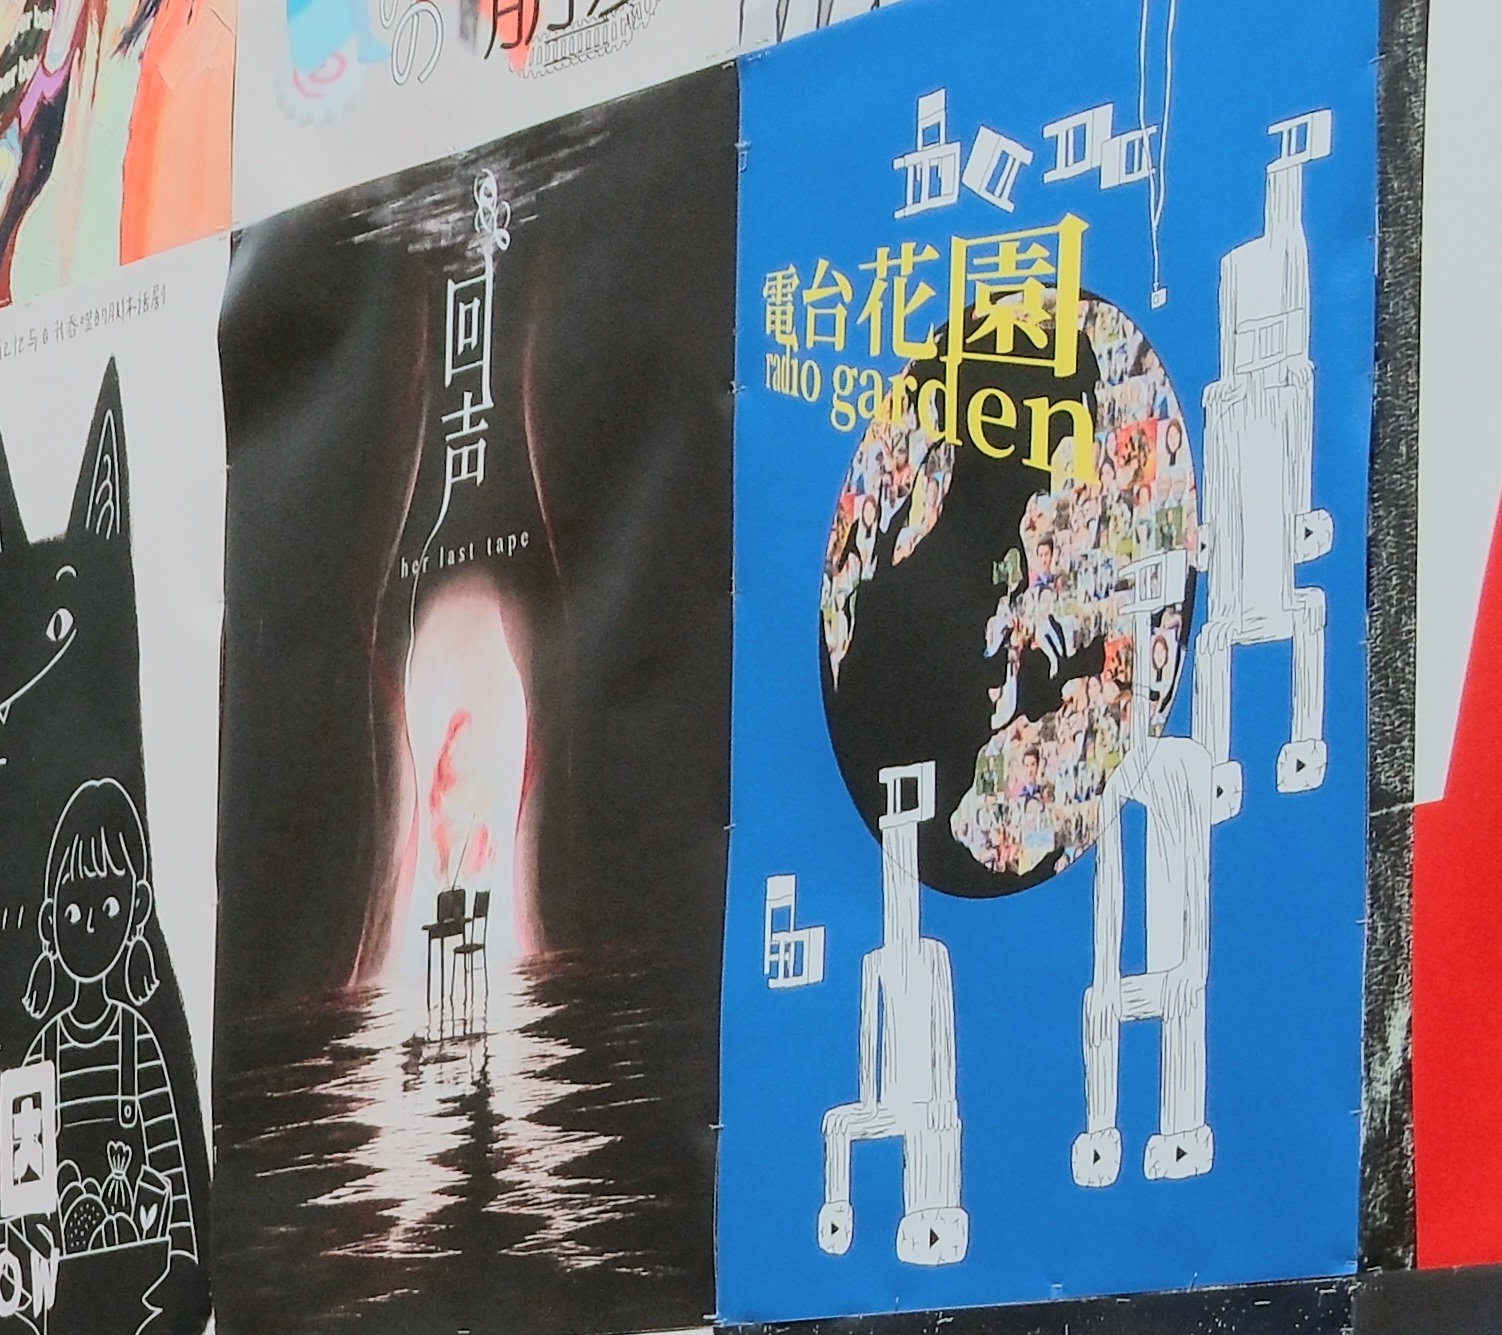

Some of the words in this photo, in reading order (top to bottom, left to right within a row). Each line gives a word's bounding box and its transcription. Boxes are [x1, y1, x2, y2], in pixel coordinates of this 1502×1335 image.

[762, 212, 1090, 379] 電台花園
[765, 350, 822, 403] radio
[830, 362, 1102, 488] garden
[400, 556, 430, 578] her
[440, 542, 475, 569] last
[487, 530, 530, 557] tape
